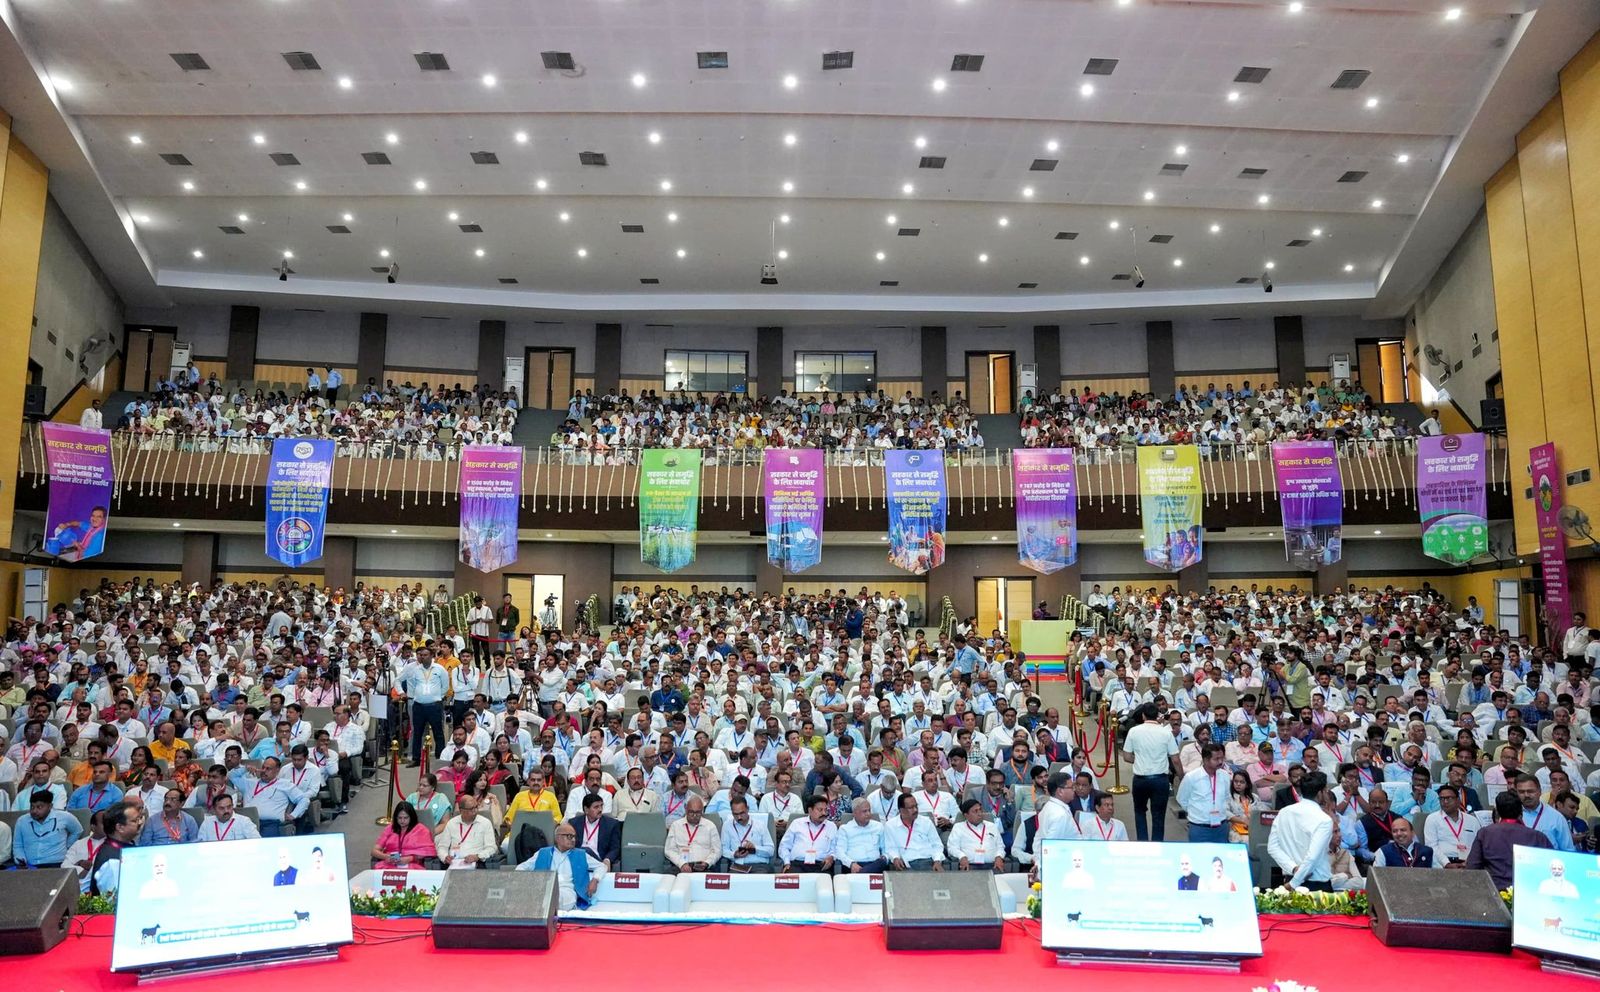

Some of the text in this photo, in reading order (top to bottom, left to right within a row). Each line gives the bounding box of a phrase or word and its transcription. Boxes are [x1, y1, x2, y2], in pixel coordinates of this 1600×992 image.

[48, 440, 107, 454] सहकार से समृद्धि
[1304, 457, 1310, 465] से
[1311, 457, 1332, 466] समृद्धि
[1424, 453, 1479, 465] सहकार से समृद्धि
[497, 462, 518, 470] समृद्धि
[1018, 463, 1041, 471] सहकार
[1050, 464, 1070, 472] समृद्धि
[1428, 463, 1476, 473] के लिए नवाचार
[676, 470, 694, 480] समृद्धि
[799, 470, 818, 480] समृद्धि
[920, 470, 938, 480] समृद्धि
